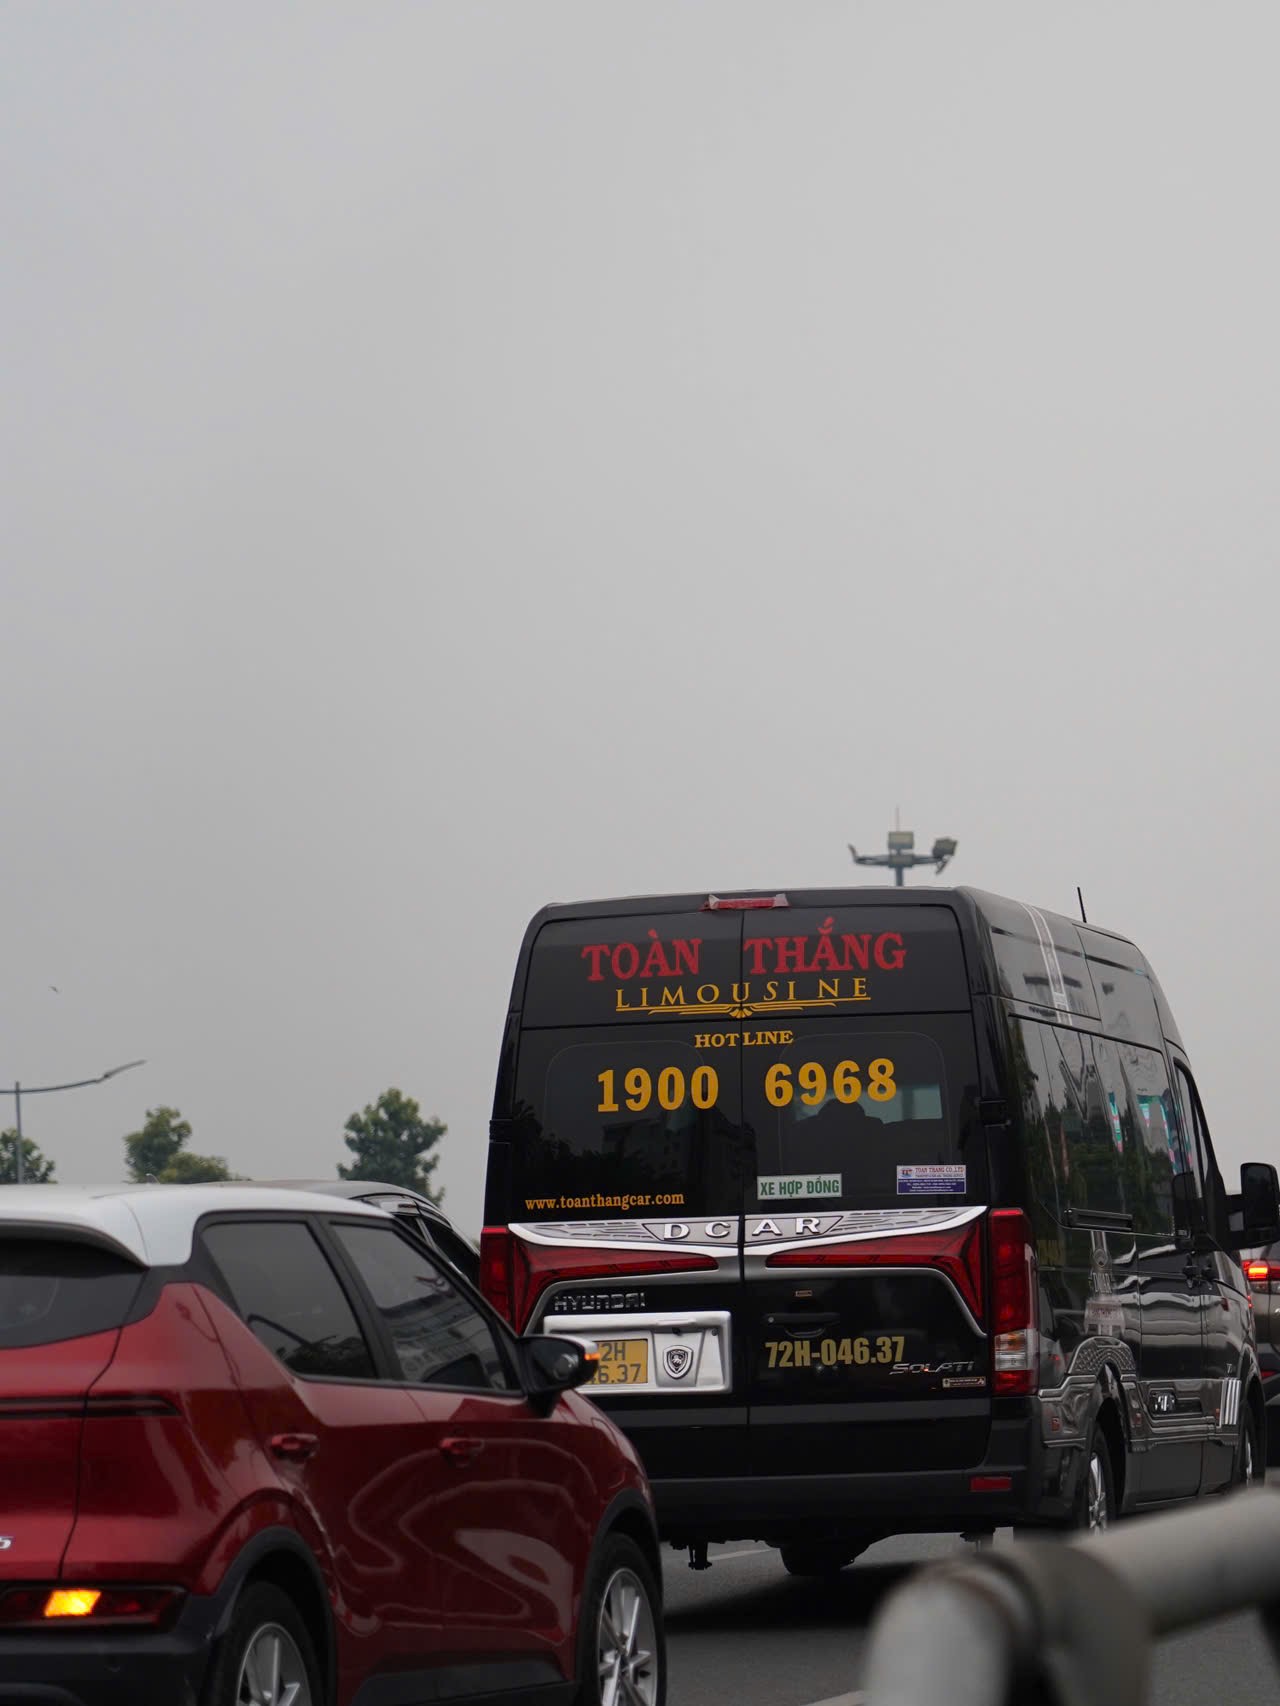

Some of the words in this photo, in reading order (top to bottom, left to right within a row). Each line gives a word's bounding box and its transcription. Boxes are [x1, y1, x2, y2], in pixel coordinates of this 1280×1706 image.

[581, 929, 703, 982] TOÀN
[743, 916, 907, 975] THẮNG
[615, 977, 868, 1008] LIMOUSINE
[596, 1065, 720, 1114] 1900
[763, 1057, 898, 1108] 6968
[760, 1182, 775, 1196] XE
[779, 1180, 803, 1197] HỢP
[806, 1176, 840, 1194] ĐỒNG
[524, 1193, 685, 1211] www.toanthangcar.com
[663, 1217, 822, 1241] DCAR
[554, 1292, 646, 1311] HYUNDAI
[595, 1343, 627, 1362] 2H
[765, 1335, 905, 1369] 72H-046.37
[889, 1361, 974, 1375] SOLATI
